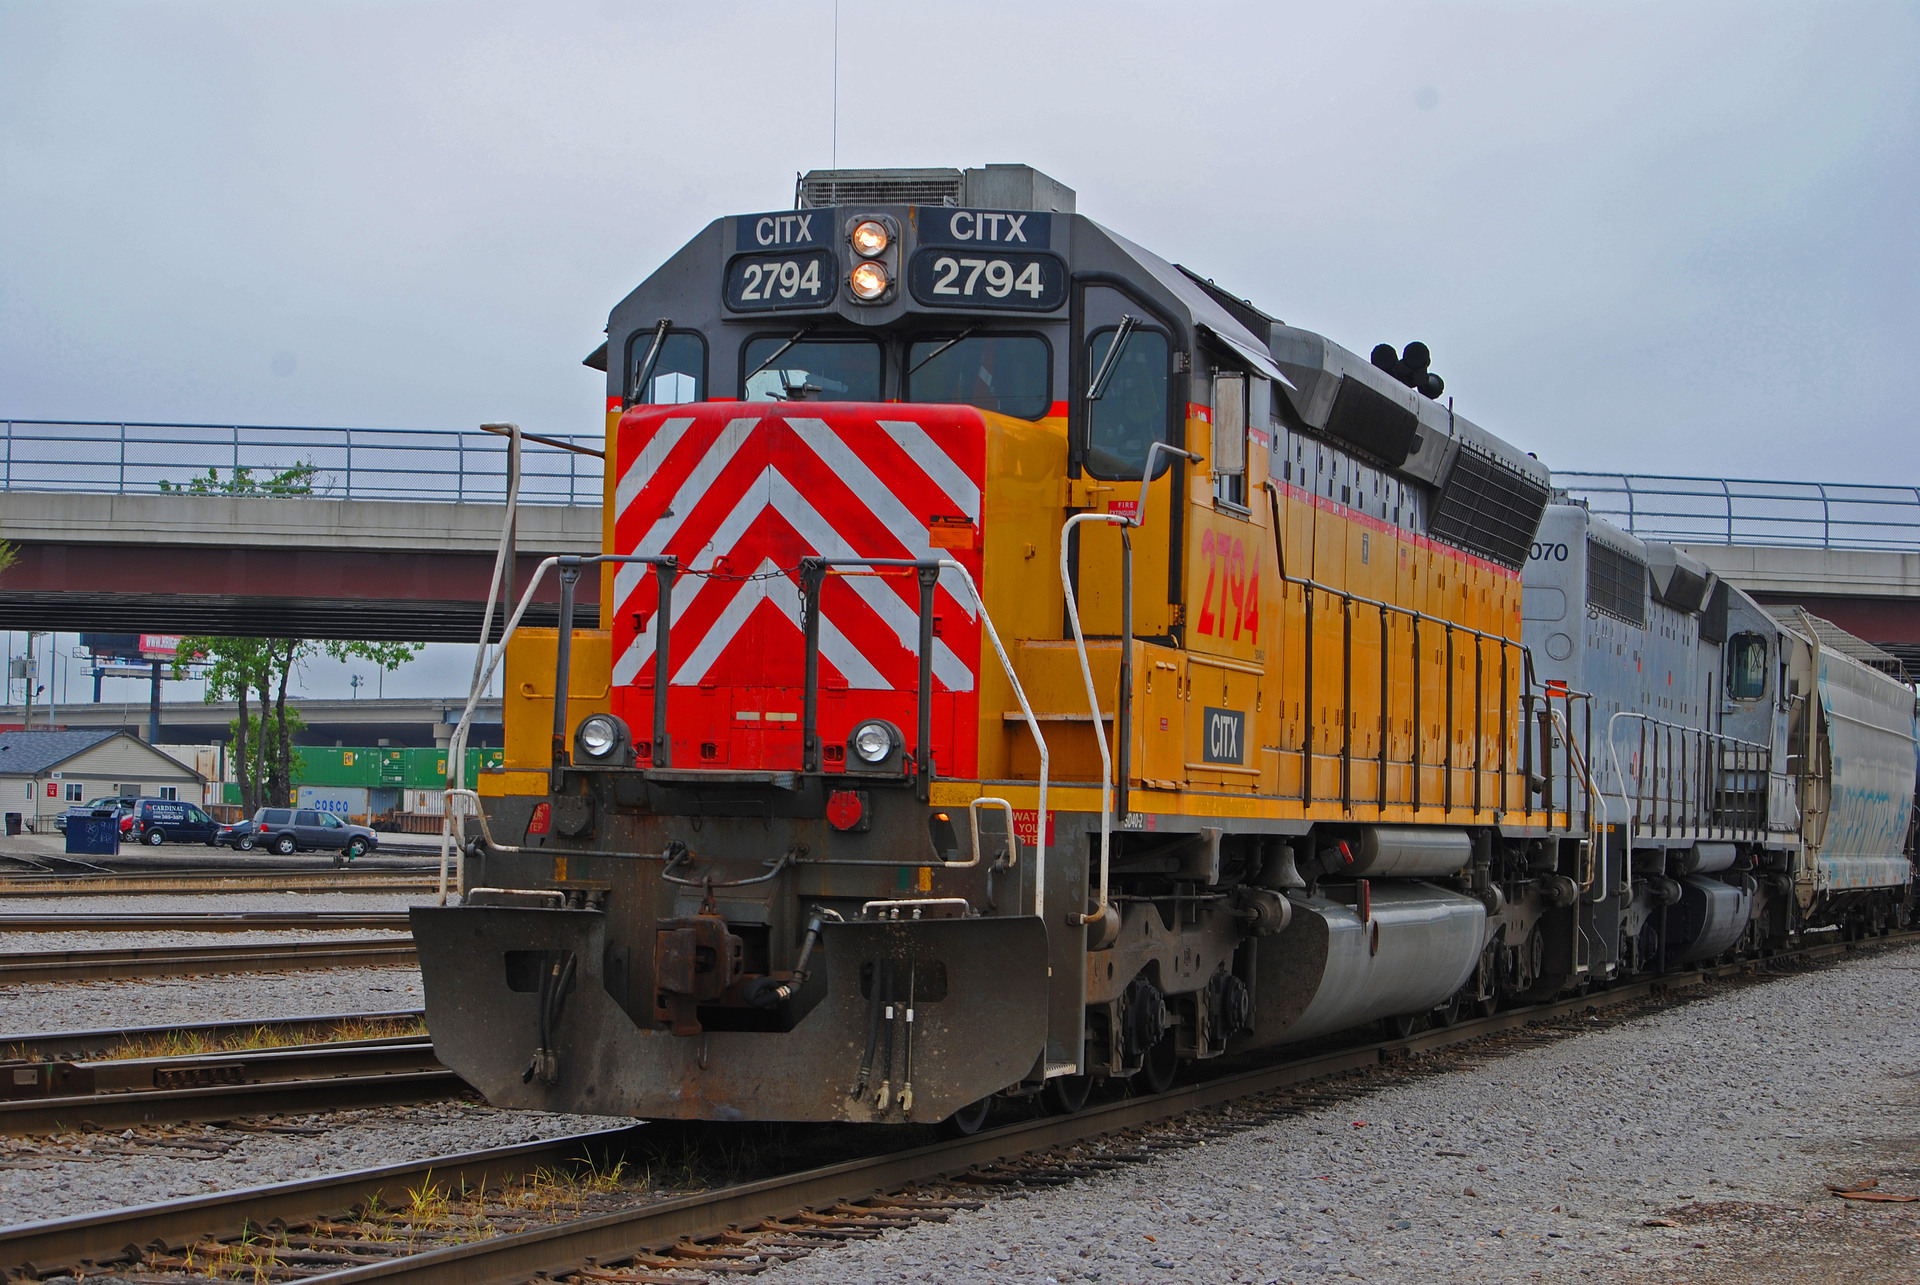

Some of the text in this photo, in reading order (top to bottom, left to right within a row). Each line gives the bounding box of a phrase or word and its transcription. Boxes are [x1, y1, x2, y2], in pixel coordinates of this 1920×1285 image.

[755, 213, 813, 246] CITX
[949, 211, 1028, 243] CITX
[741, 259, 822, 301] 2794
[932, 257, 1044, 299] 2794
[1529, 542, 1569, 561] 070
[1197, 527, 1260, 646] 2794
[1211, 713, 1238, 758] CITX
[152, 804, 185, 812] CARDINAL
[314, 799, 349, 812] COSCO
[1012, 811, 1053, 822] WATH
[529, 822, 543, 832] TEP
[1019, 823, 1038, 833] YOU
[1019, 834, 1038, 844] STE
